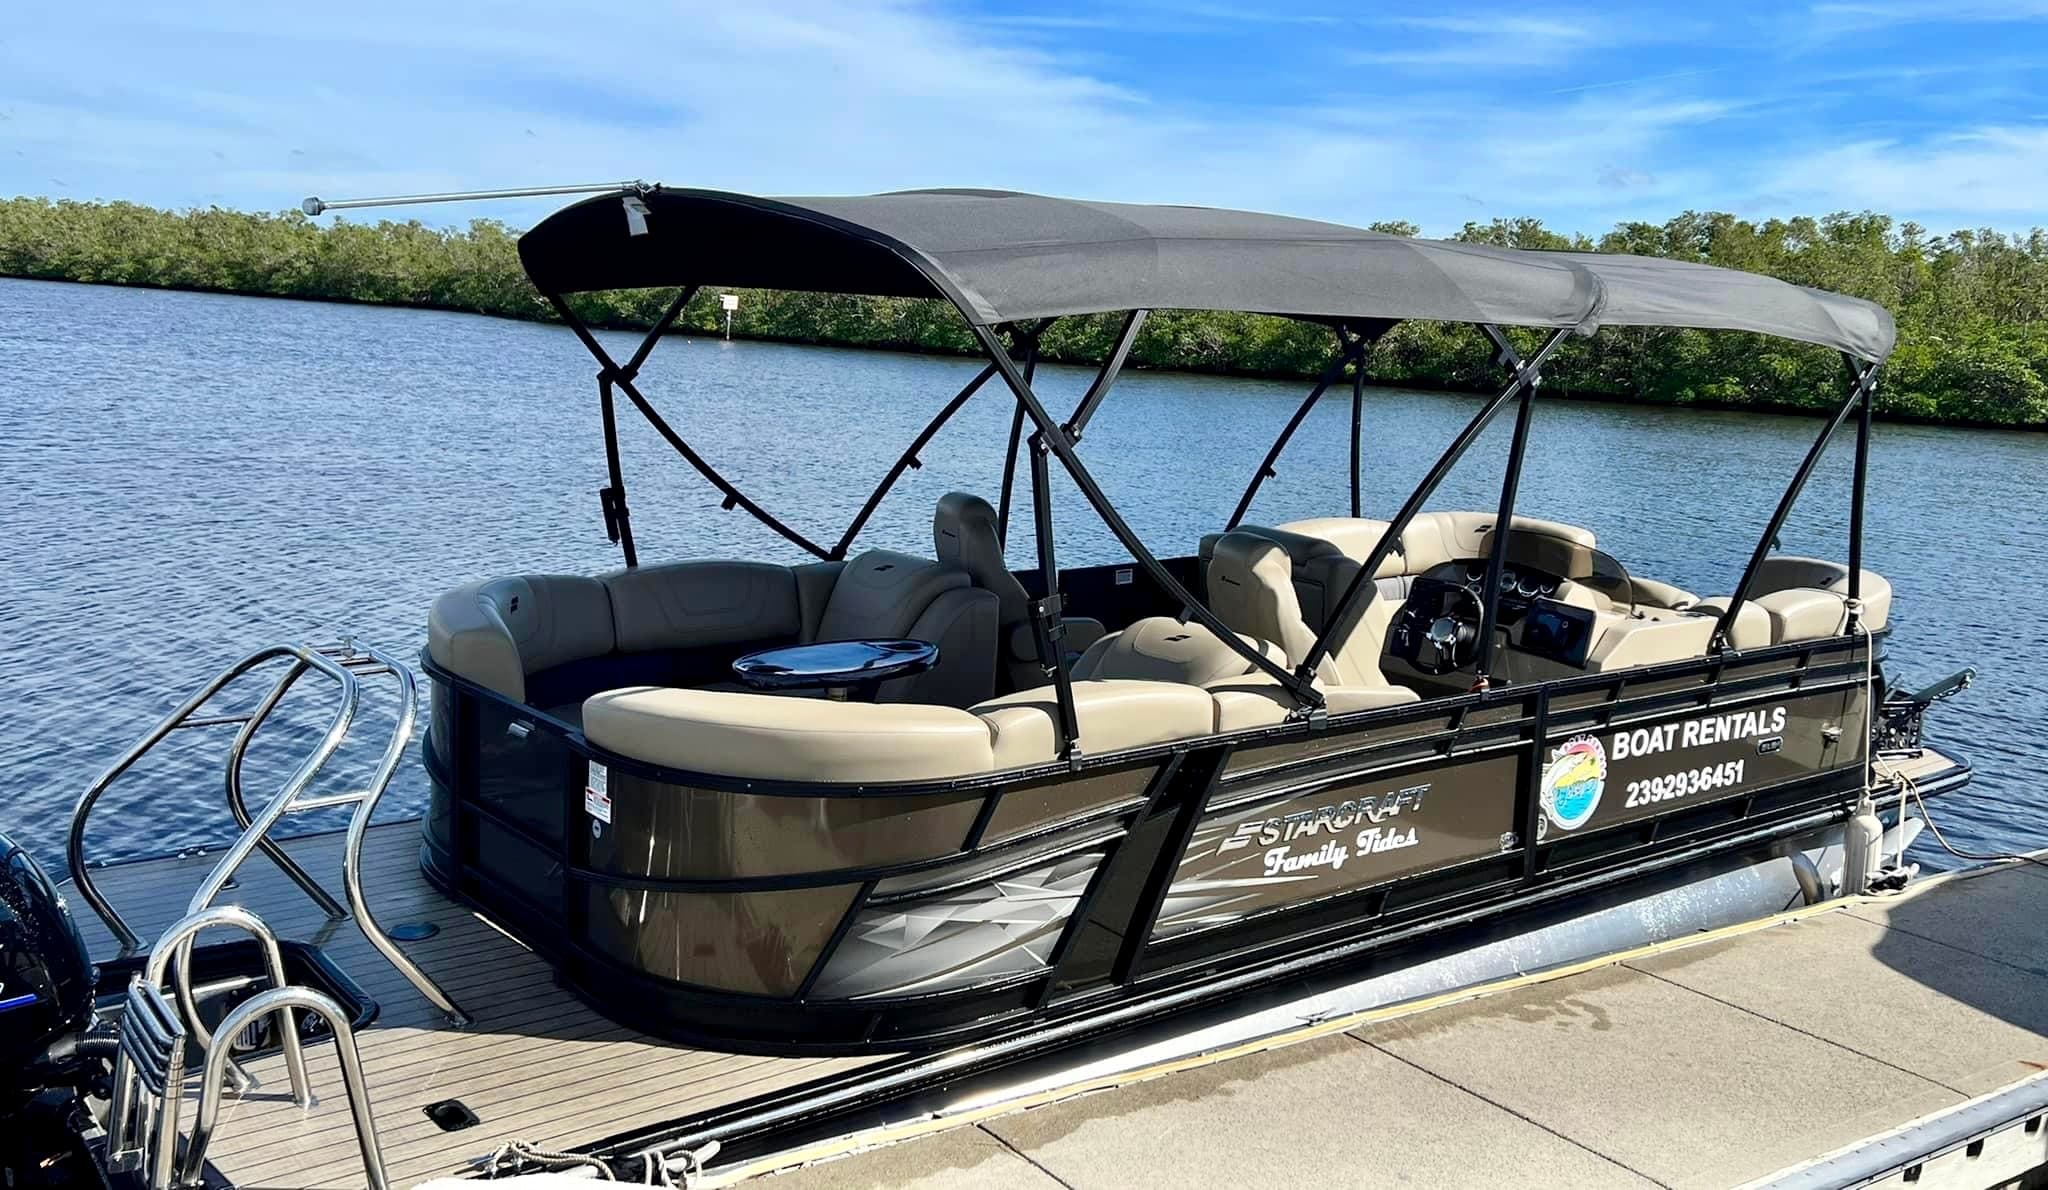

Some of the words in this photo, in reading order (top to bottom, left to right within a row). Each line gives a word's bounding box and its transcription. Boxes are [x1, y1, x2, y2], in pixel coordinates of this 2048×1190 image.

[1612, 723, 1679, 761] BOAT
[1682, 706, 1786, 748] RENTALS
[1258, 784, 1432, 846] STARCRAFT
[1264, 840, 1349, 876] Family
[1356, 827, 1419, 857] Tides
